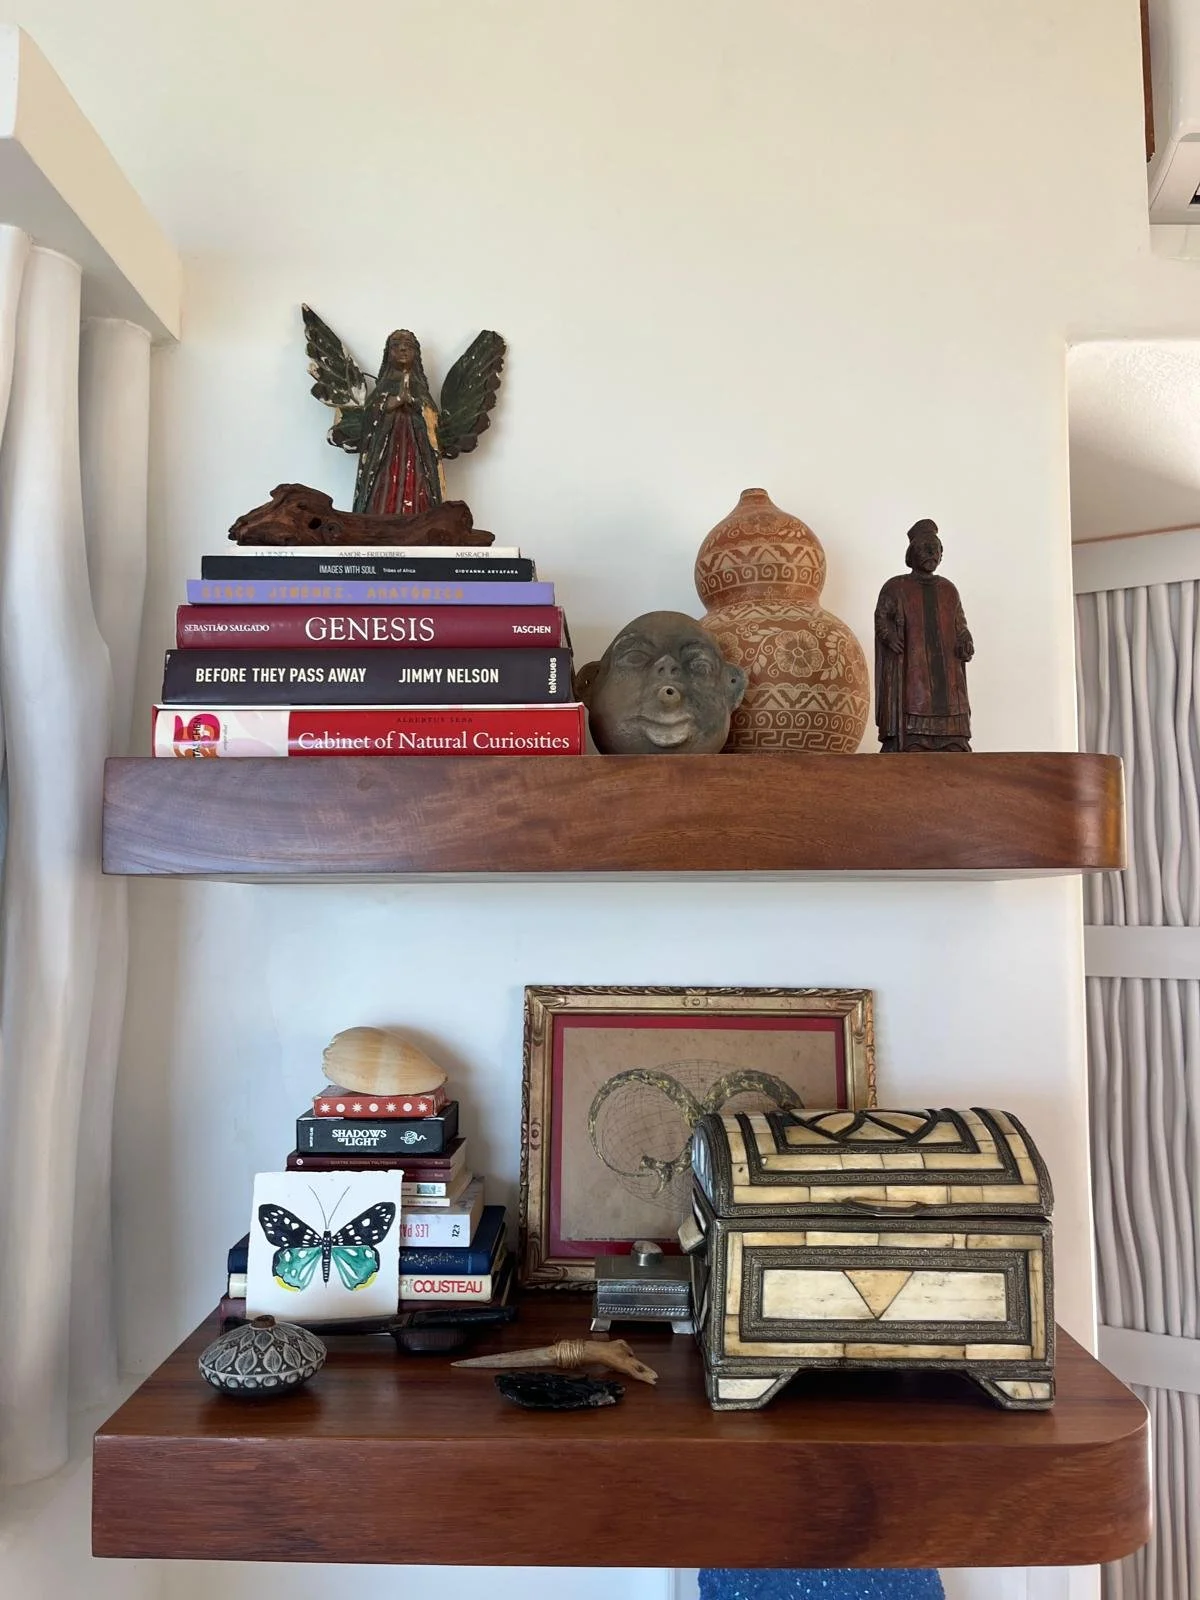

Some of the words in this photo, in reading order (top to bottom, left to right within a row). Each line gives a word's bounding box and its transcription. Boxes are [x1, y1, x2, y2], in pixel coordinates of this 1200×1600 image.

[319, 565, 344, 574] IMAGES
[344, 565, 361, 574] WITH
[361, 566, 377, 575] SOUL
[184, 623, 228, 632] SEBASTIÃO
[229, 624, 270, 632] SALGADO
[305, 617, 435, 641] GENESIS
[512, 625, 552, 634] TASCHEN
[196, 668, 247, 683] BEFORE
[252, 668, 287, 683] THEY
[290, 668, 324, 683] PASS
[327, 668, 367, 683] AWAY
[398, 668, 443, 683] JIMMY
[447, 668, 499, 683] NELSON
[548, 657, 557, 694] teNeues
[298, 732, 371, 750] Cabinet
[375, 731, 396, 749] of
[398, 730, 468, 749] Natural
[473, 731, 570, 750] Curiosities
[331, 1129, 387, 1138] SHADOWS
[344, 1137, 379, 1147] LIGHT
[415, 1224, 429, 1238] LES
[413, 1280, 482, 1293] COUSTEAU
